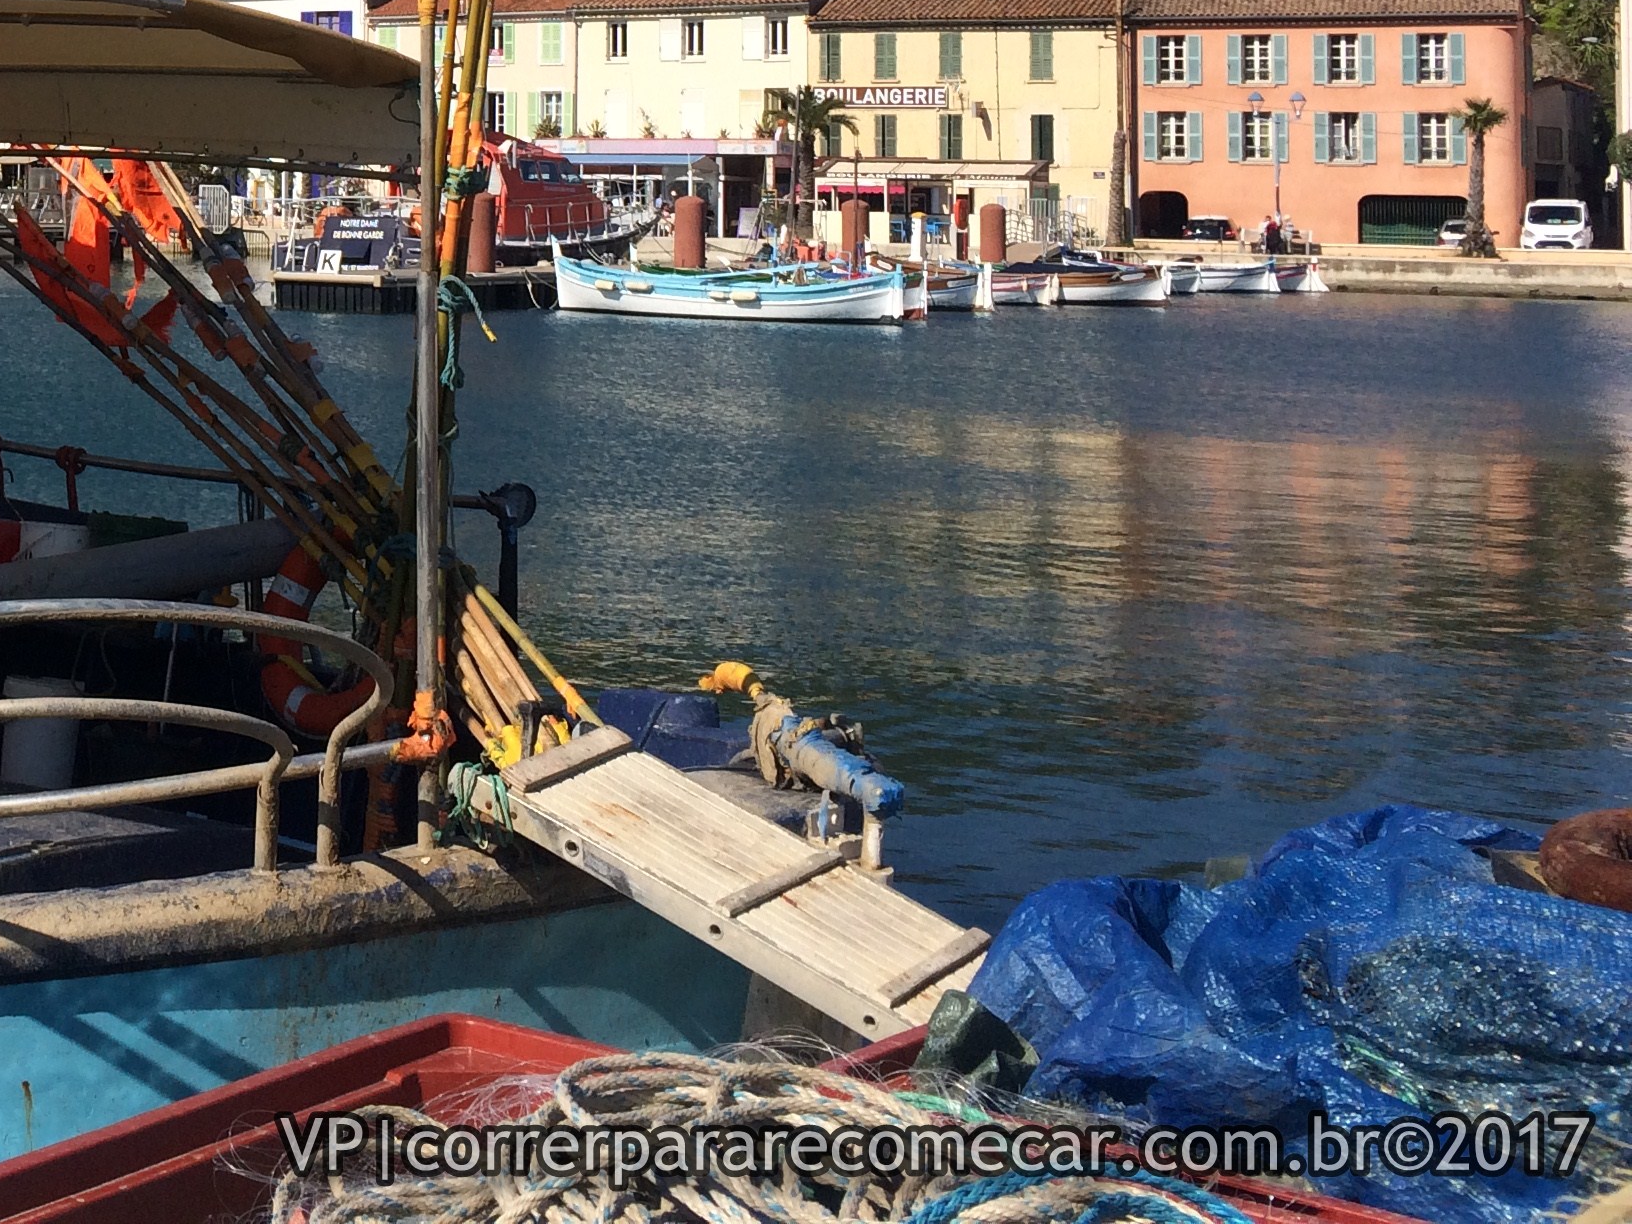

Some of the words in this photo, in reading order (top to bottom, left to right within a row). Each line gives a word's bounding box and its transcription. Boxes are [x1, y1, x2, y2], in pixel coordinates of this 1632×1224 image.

[814, 88, 946, 105] BOULANGERIE
[340, 219, 360, 227] NOTRE
[361, 219, 379, 227] DAME
[333, 230, 341, 239] DE
[341, 230, 363, 239] BONNE
[363, 231, 384, 239] GARDE
[322, 253, 336, 270] K
